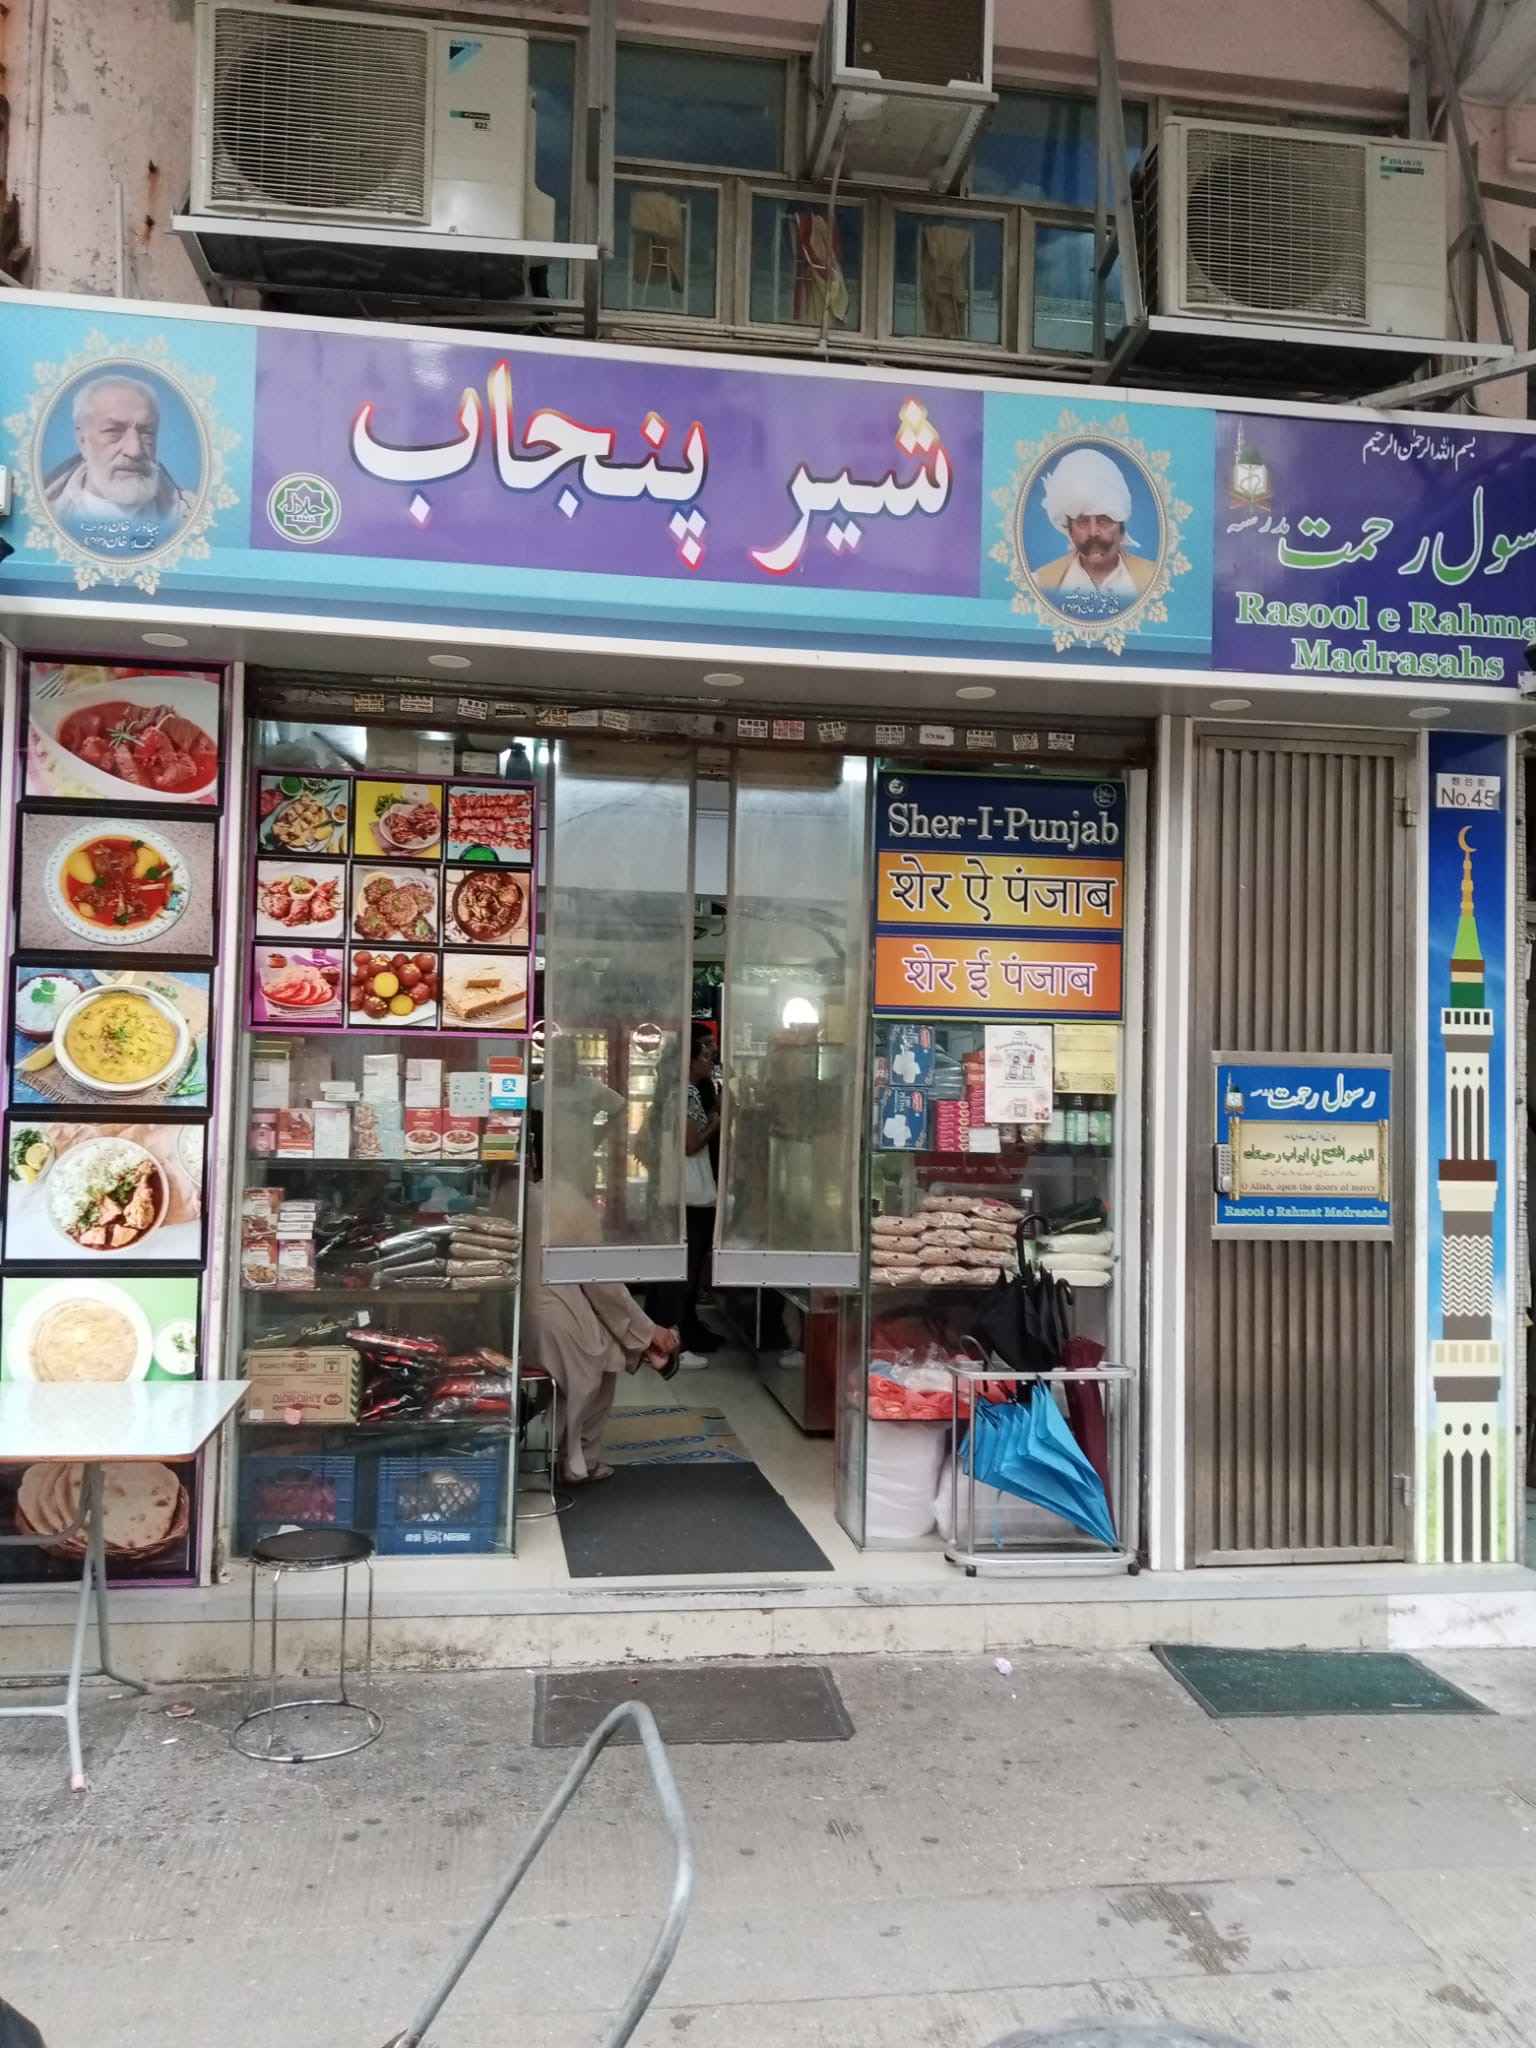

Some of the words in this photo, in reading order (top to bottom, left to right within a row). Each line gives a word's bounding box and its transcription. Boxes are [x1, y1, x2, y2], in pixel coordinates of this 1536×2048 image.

[351, 358, 708, 570] پنجاب
[1455, 436, 1476, 472] بسم
[748, 397, 952, 574] شیر
[1235, 591, 1370, 631] Rasool
[1377, 607, 1400, 632] e
[1408, 601, 1536, 641] Rahma
[1291, 638, 1505, 680] Madrasahs
[1441, 787, 1494, 807] No.45
[888, 802, 1119, 850] Sher-I-Punjab
[889, 856, 953, 910] शेर
[961, 857, 994, 922] ऐ
[1002, 867, 1118, 917] पंजाब
[904, 945, 958, 992] शेर
[965, 949, 991, 998] ई
[1000, 955, 1096, 996] पंजाब
[1268, 1086, 1319, 1110] رحمت
[1322, 1073, 1376, 1113] رسول
[1299, 1183, 1312, 1192] the
[1224, 1205, 1265, 1216] Rasool
[1267, 1208, 1274, 1217] e
[1276, 1206, 1322, 1217] Rahmat
